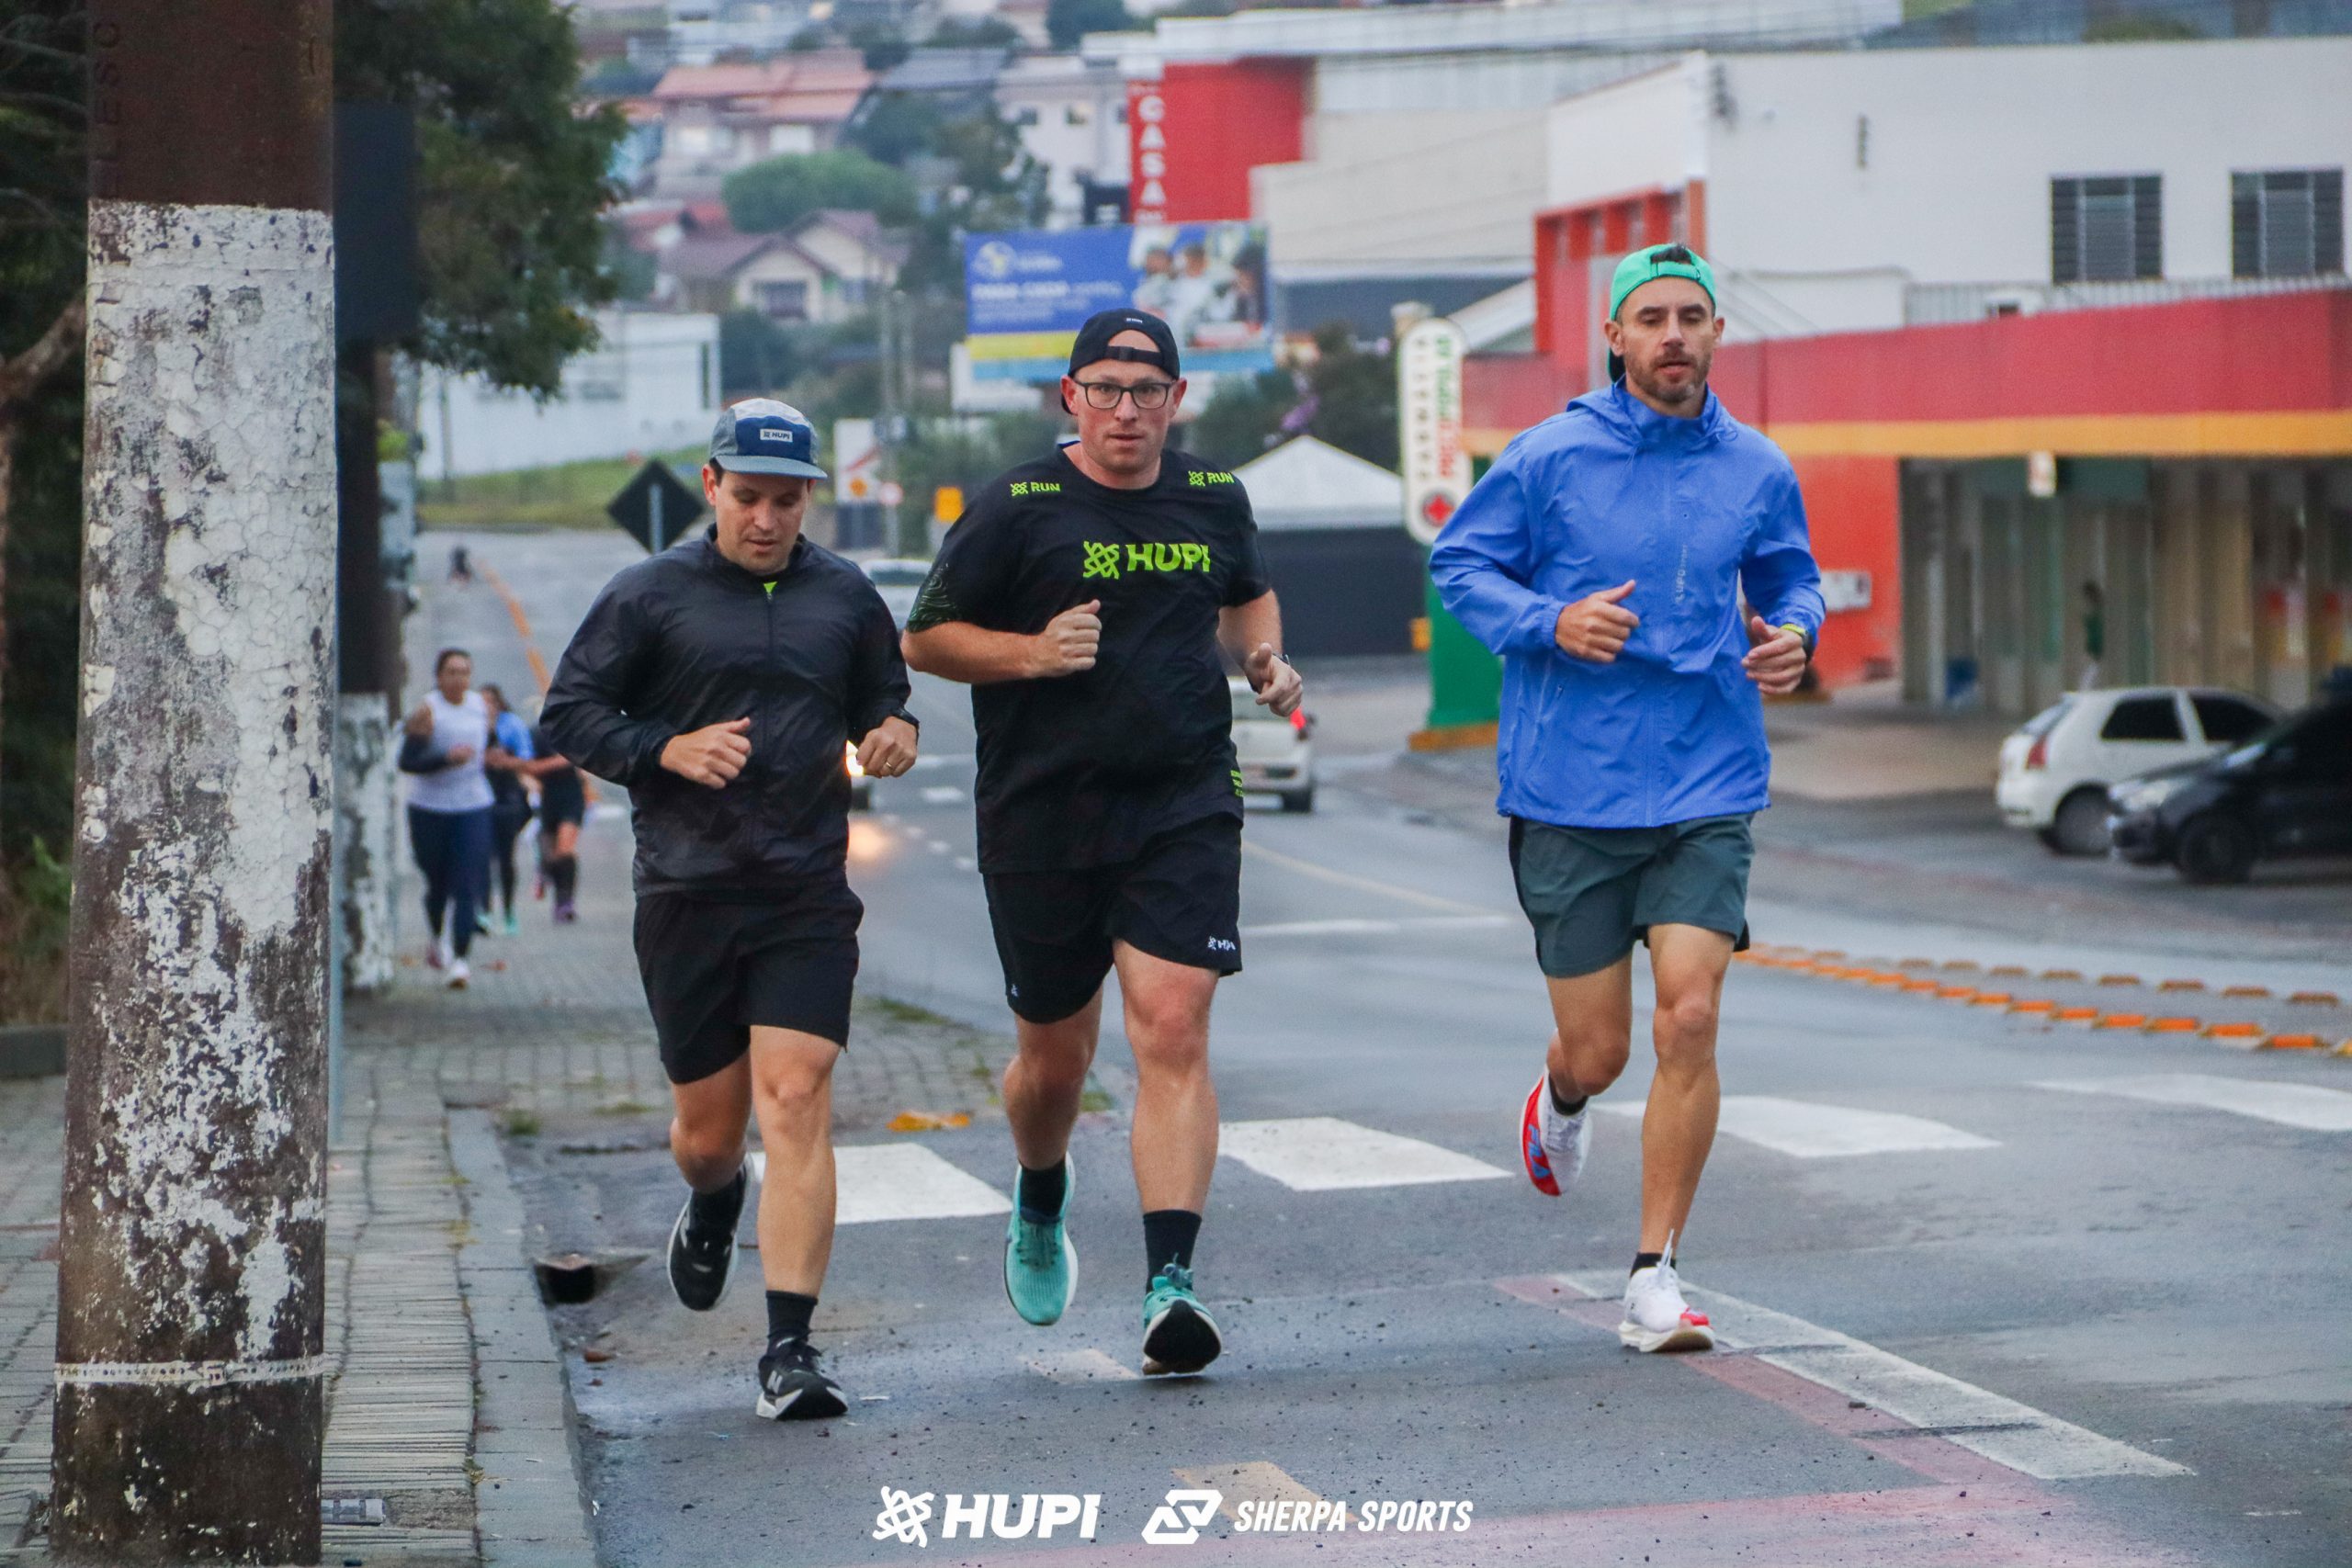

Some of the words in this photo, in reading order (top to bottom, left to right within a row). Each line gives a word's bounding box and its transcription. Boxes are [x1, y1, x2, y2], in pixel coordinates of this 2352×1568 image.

[1138, 95, 1166, 206] CASA
[1031, 481, 1061, 492] RUN
[1207, 471, 1235, 484] RUN
[1125, 542, 1211, 572] HUPI
